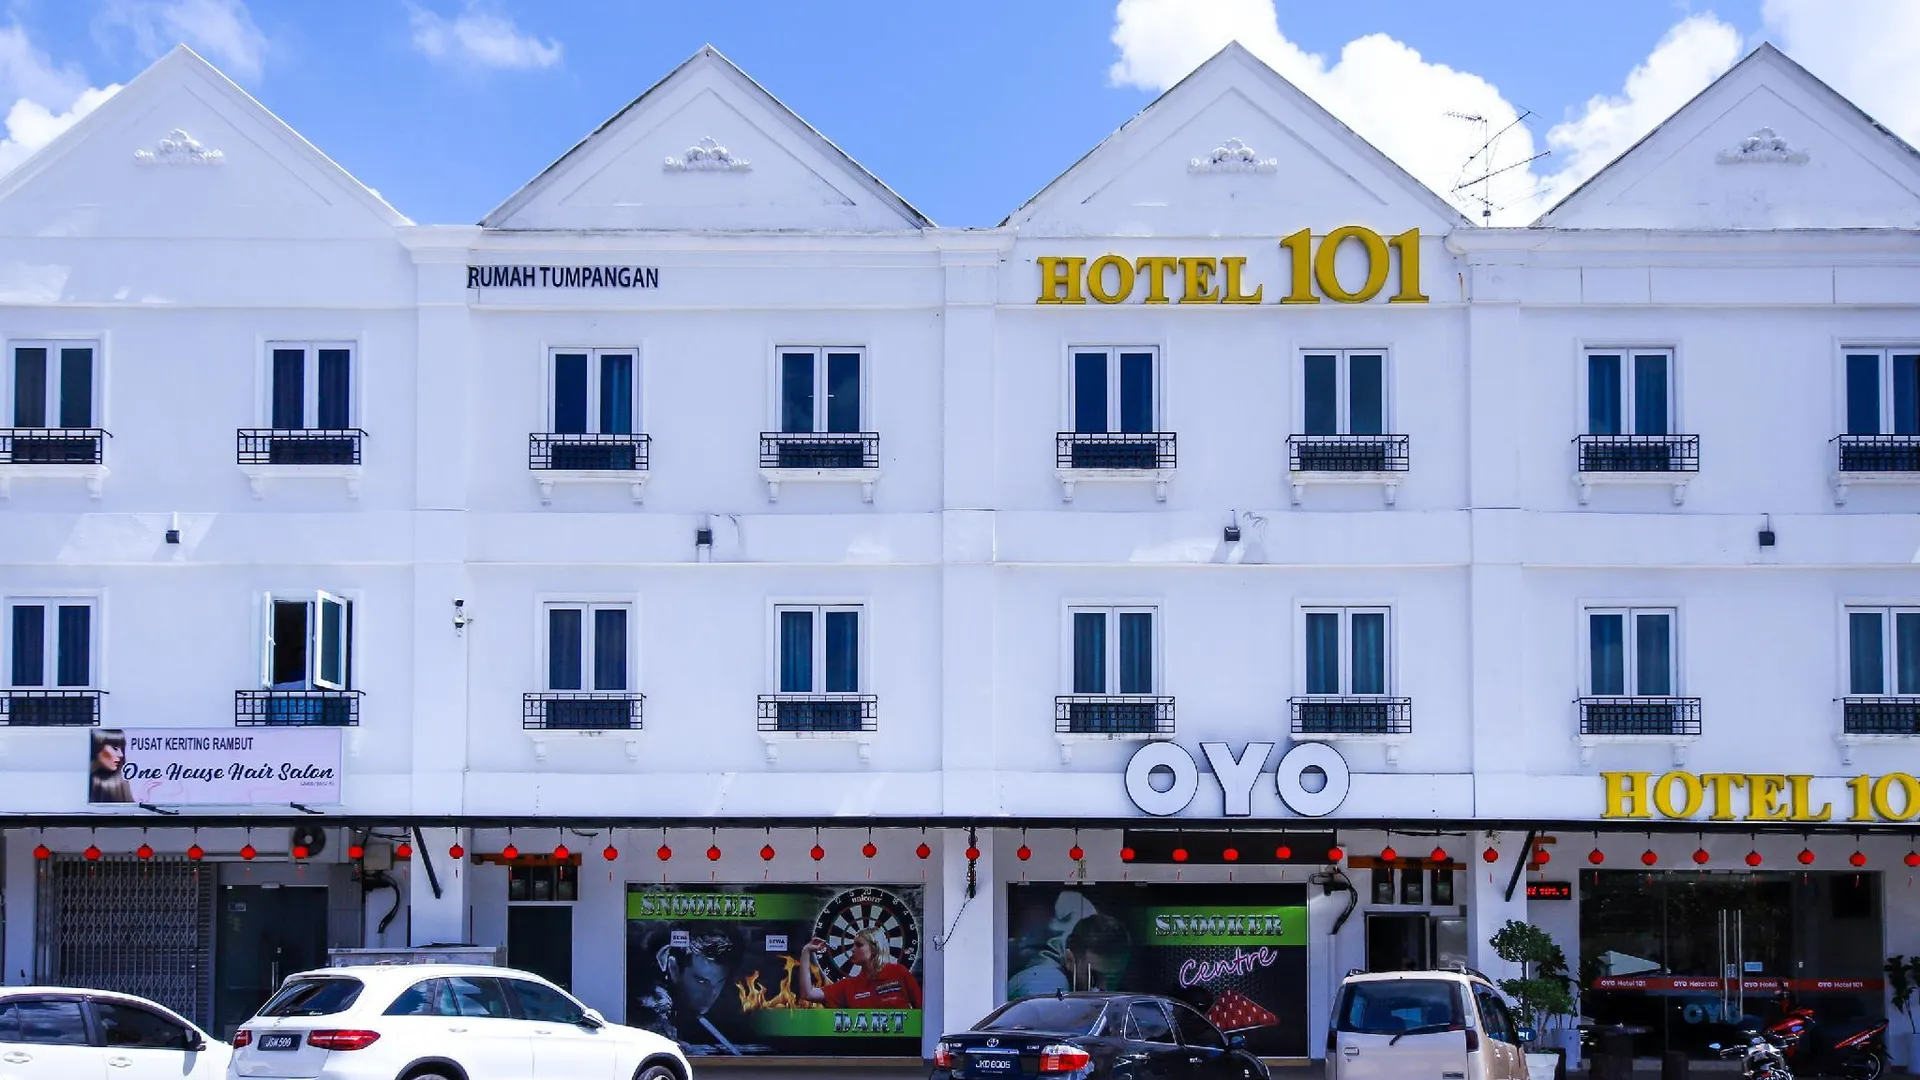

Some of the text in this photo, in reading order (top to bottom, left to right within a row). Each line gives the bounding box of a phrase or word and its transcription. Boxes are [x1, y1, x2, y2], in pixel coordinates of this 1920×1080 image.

[1036, 225, 1430, 304] HOTEL 101
[467, 266, 659, 289] RUMAH TUMPANGAN
[131, 737, 254, 750] PUSAT KERITING RAMBUT
[123, 762, 334, 783] One House Hair Salon
[1124, 740, 1350, 817] OYO
[1600, 770, 1920, 821] HOTEL 10
[640, 894, 757, 917] SNOOKER
[851, 895, 881, 903] unicorn
[1155, 914, 1284, 937] SNOOKER
[1179, 946, 1278, 989] Centre
[833, 1011, 908, 1033] DART
